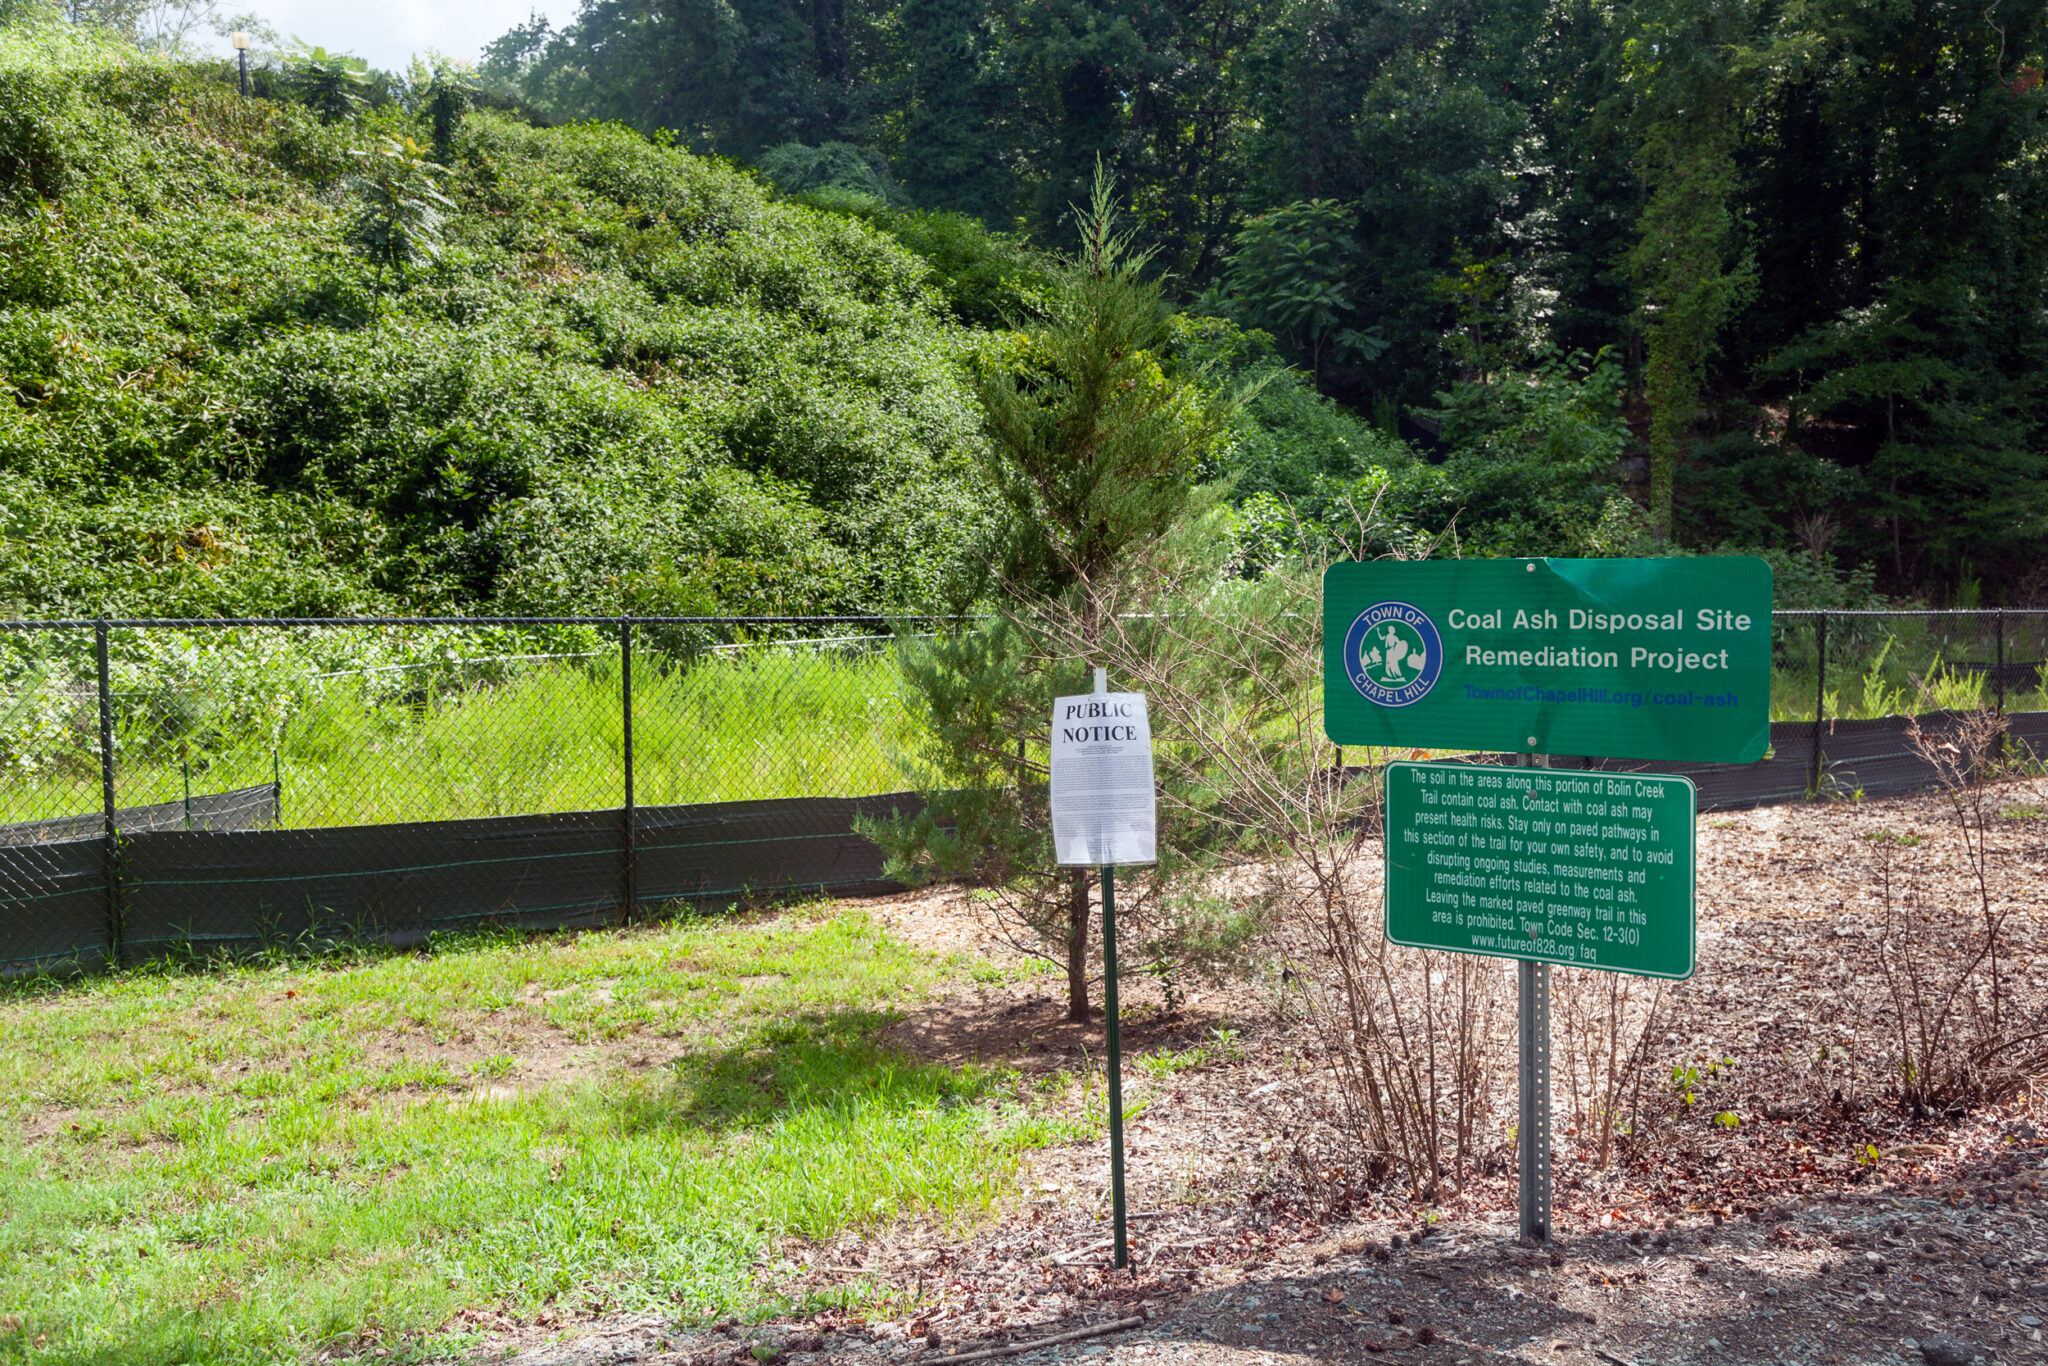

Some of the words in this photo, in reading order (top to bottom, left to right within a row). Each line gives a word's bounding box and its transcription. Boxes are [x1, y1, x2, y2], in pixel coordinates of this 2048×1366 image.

[1363, 606, 1403, 626] TOWN
[1405, 610, 1424, 626] OF
[1448, 609, 1501, 630] Coal
[1512, 609, 1558, 630] Ash
[1569, 609, 1683, 634] Disposal
[1697, 609, 1751, 631] Site
[1465, 645, 1618, 668] Remediation
[1631, 647, 1729, 673] Project
[1355, 673, 1403, 702] CHAPEL
[1404, 678, 1430, 700] HILL
[1463, 684, 1739, 708] TownofChapelHill.org/coal-ash
[1066, 702, 1133, 720] PUBLIC
[1062, 725, 1137, 743] NOTICE
[1411, 769, 1426, 783] The
[1430, 771, 1445, 785] soil
[1449, 771, 1456, 785] in
[1460, 772, 1474, 786] the
[1478, 776, 1502, 788] areas
[1506, 774, 1532, 793] along
[1536, 776, 1551, 791] this
[1556, 778, 1589, 794] portion
[1593, 780, 1603, 794] of
[1608, 780, 1631, 796] Bolin
[1636, 781, 1664, 798] Creek
[1421, 789, 1437, 804] Trail
[1442, 792, 1473, 806] contain
[1478, 794, 1496, 808] coal
[1501, 795, 1518, 809] ash.
[1522, 796, 1559, 812] Contact
[1563, 799, 1582, 814] with
[1587, 801, 1606, 816] coal
[1611, 802, 1628, 817] ash
[1632, 806, 1652, 822] may
[1416, 812, 1447, 825] present
[1451, 812, 1477, 827] health
[1481, 814, 1505, 829] risks.
[1508, 815, 1528, 834] Stay
[1532, 818, 1551, 836] only
[1555, 822, 1566, 834] on
[1570, 822, 1598, 838] paved
[1602, 824, 1646, 843] pathways
[1651, 826, 1659, 841] in
[1404, 828, 1419, 843] this
[1423, 831, 1455, 845] section
[1459, 833, 1467, 846] of
[1472, 834, 1485, 848] the
[1490, 836, 1506, 850] trail
[1510, 836, 1523, 851] for
[1527, 840, 1547, 856] your
[1551, 843, 1570, 855] own
[1574, 842, 1606, 861] safety,
[1611, 846, 1628, 860] and
[1633, 847, 1642, 862] to
[1647, 849, 1673, 864] avoid
[1427, 850, 1470, 871] disrupting
[1474, 856, 1509, 874] ongoing
[1514, 859, 1549, 877] studies,
[1554, 864, 1623, 882] measurements
[1628, 868, 1645, 884] and
[1434, 871, 1485, 888] remediation
[1490, 875, 1520, 891] efforts
[1524, 878, 1556, 895] related
[1561, 881, 1570, 896] to
[1574, 882, 1589, 898] the
[1593, 885, 1613, 900] coal
[1618, 887, 1637, 903] ash.
[1426, 888, 1458, 908] Leaving
[1462, 892, 1476, 907] the
[1480, 895, 1513, 910] marked
[1517, 899, 1543, 914] paved
[1548, 903, 1591, 922] greenway
[1596, 905, 1613, 921] trail
[1617, 907, 1625, 922] in
[1630, 908, 1646, 925] this
[1432, 911, 1452, 923] area
[1456, 910, 1463, 925] is
[1468, 913, 1515, 930] prohibited.
[1520, 917, 1543, 933] Town
[1548, 920, 1572, 937] Code
[1577, 923, 1598, 940] Sec.
